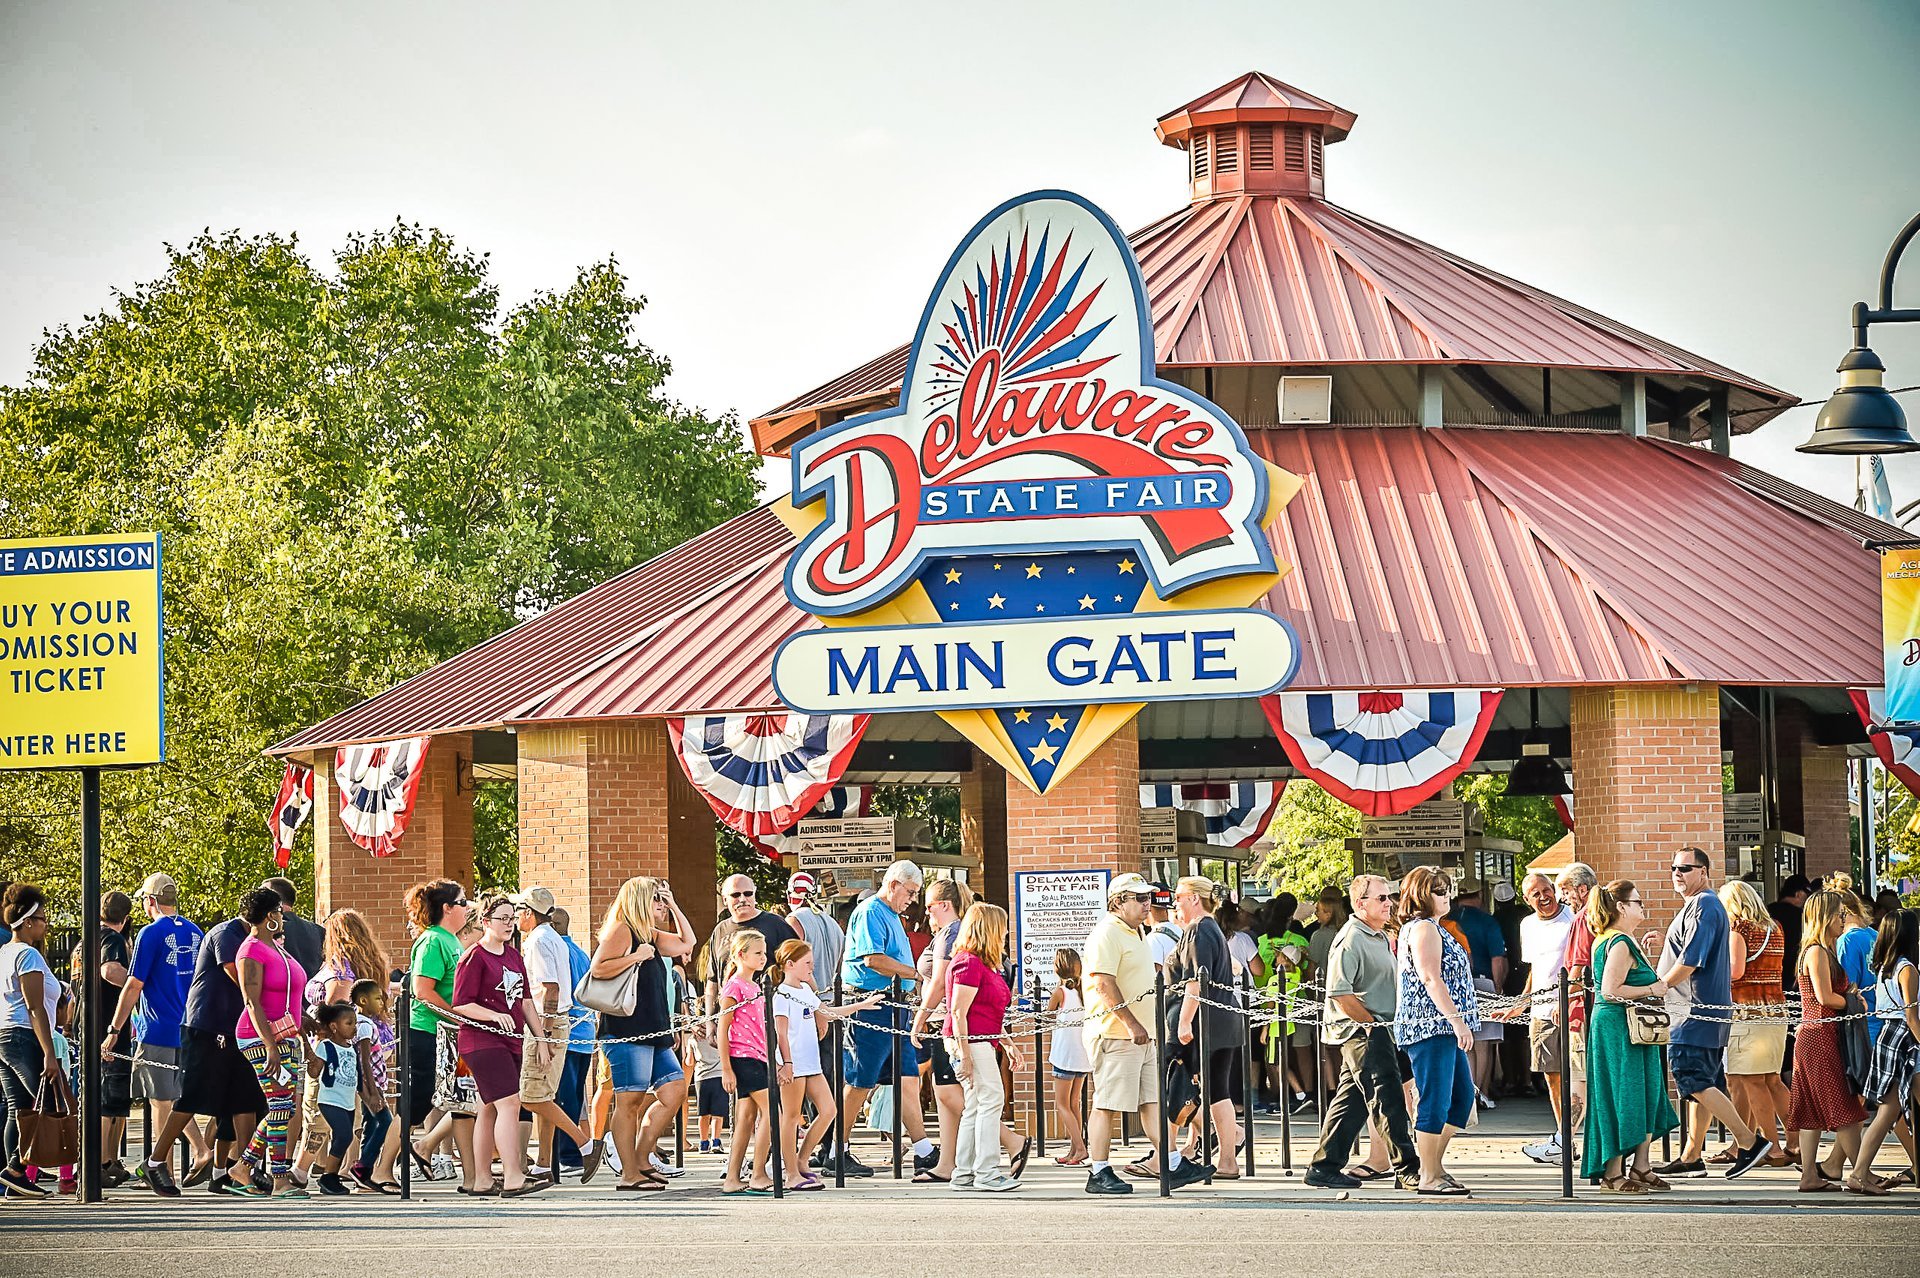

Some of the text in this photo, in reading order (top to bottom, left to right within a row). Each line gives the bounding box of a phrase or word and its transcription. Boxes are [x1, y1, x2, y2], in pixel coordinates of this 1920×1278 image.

[804, 349, 1232, 595] Delaware
[926, 477, 1219, 516] STATE FAIR
[0, 547, 152, 571] E ADMISSION
[50, 599, 131, 626] YOUR
[826, 628, 1237, 696] MAIN GATE
[10, 667, 106, 693] TICKET
[66, 732, 126, 754] HERE
[800, 825, 842, 834] ADMISSION
[1743, 833, 1760, 841] 1PM
[1147, 845, 1156, 853] AT
[1158, 845, 1174, 853] 1PM
[1365, 840, 1403, 848] CARNIVAL
[1405, 840, 1431, 848] OPENS
[1444, 839, 1461, 847] 1PM
[802, 856, 838, 865] CARNIVAL
[839, 855, 864, 863] OPENS
[876, 854, 892, 862] 1PM
[1026, 875, 1099, 884] DELAWARE
[1026, 884, 1067, 892] STATE
